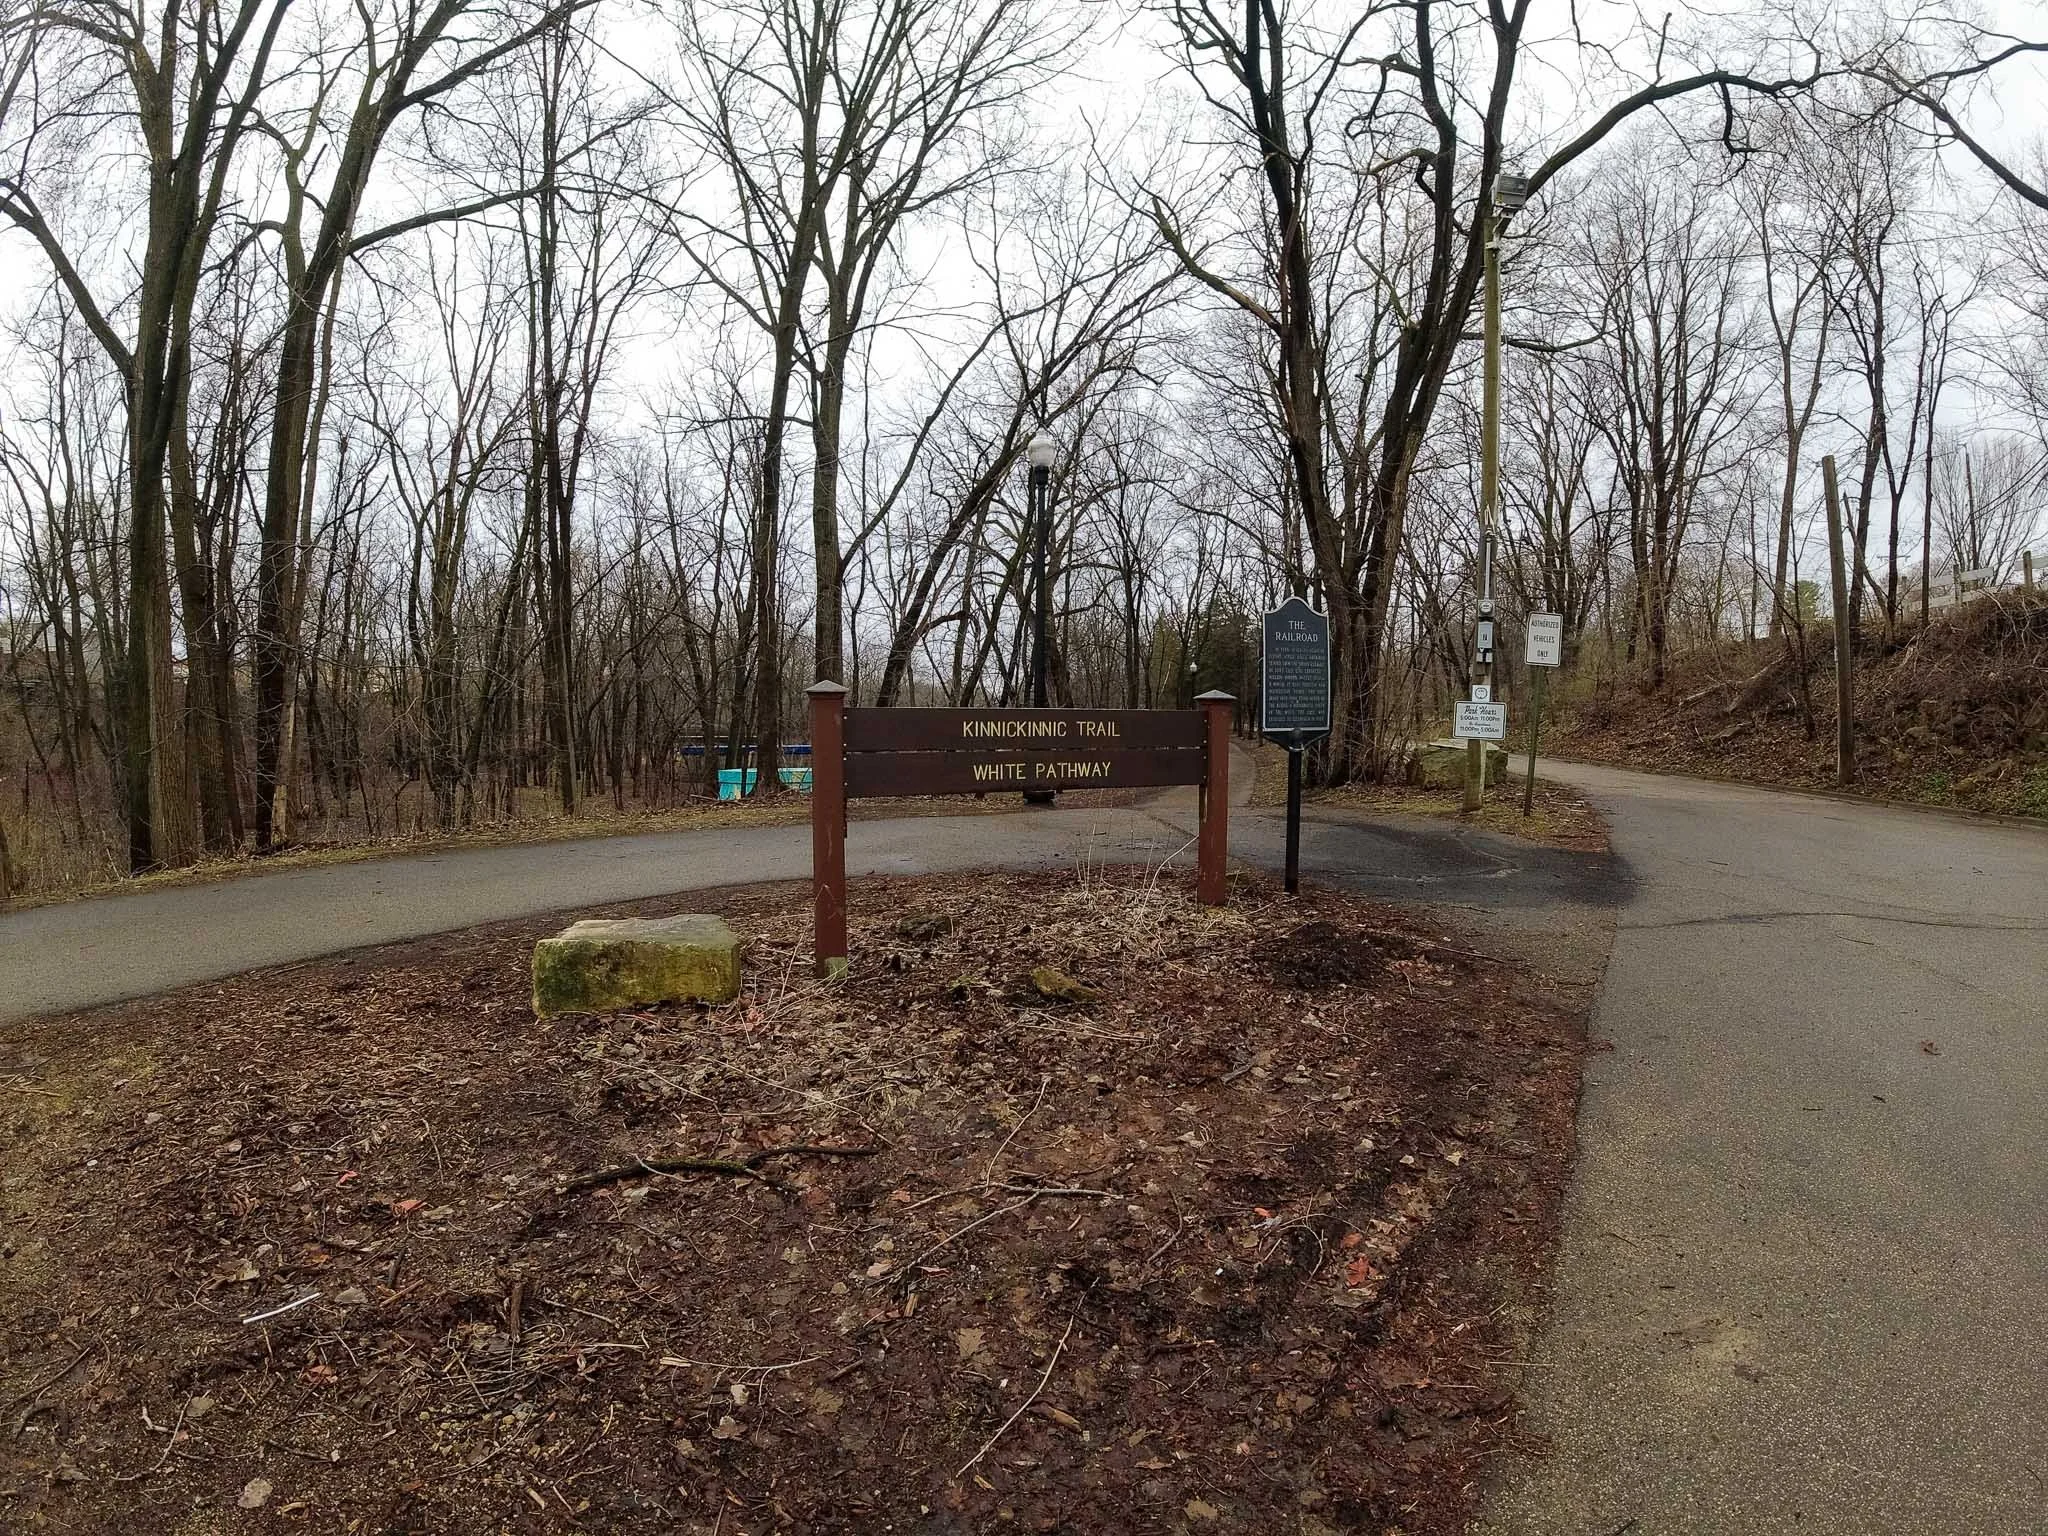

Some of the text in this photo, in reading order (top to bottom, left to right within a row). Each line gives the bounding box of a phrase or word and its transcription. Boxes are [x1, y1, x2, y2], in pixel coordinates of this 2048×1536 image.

[1288, 620, 1306, 630] THE
[1275, 631, 1318, 642] RAILROAD
[962, 720, 1121, 737] KINNICKINNIC TRAIL
[973, 761, 1111, 781] WHITE PATHWAY
